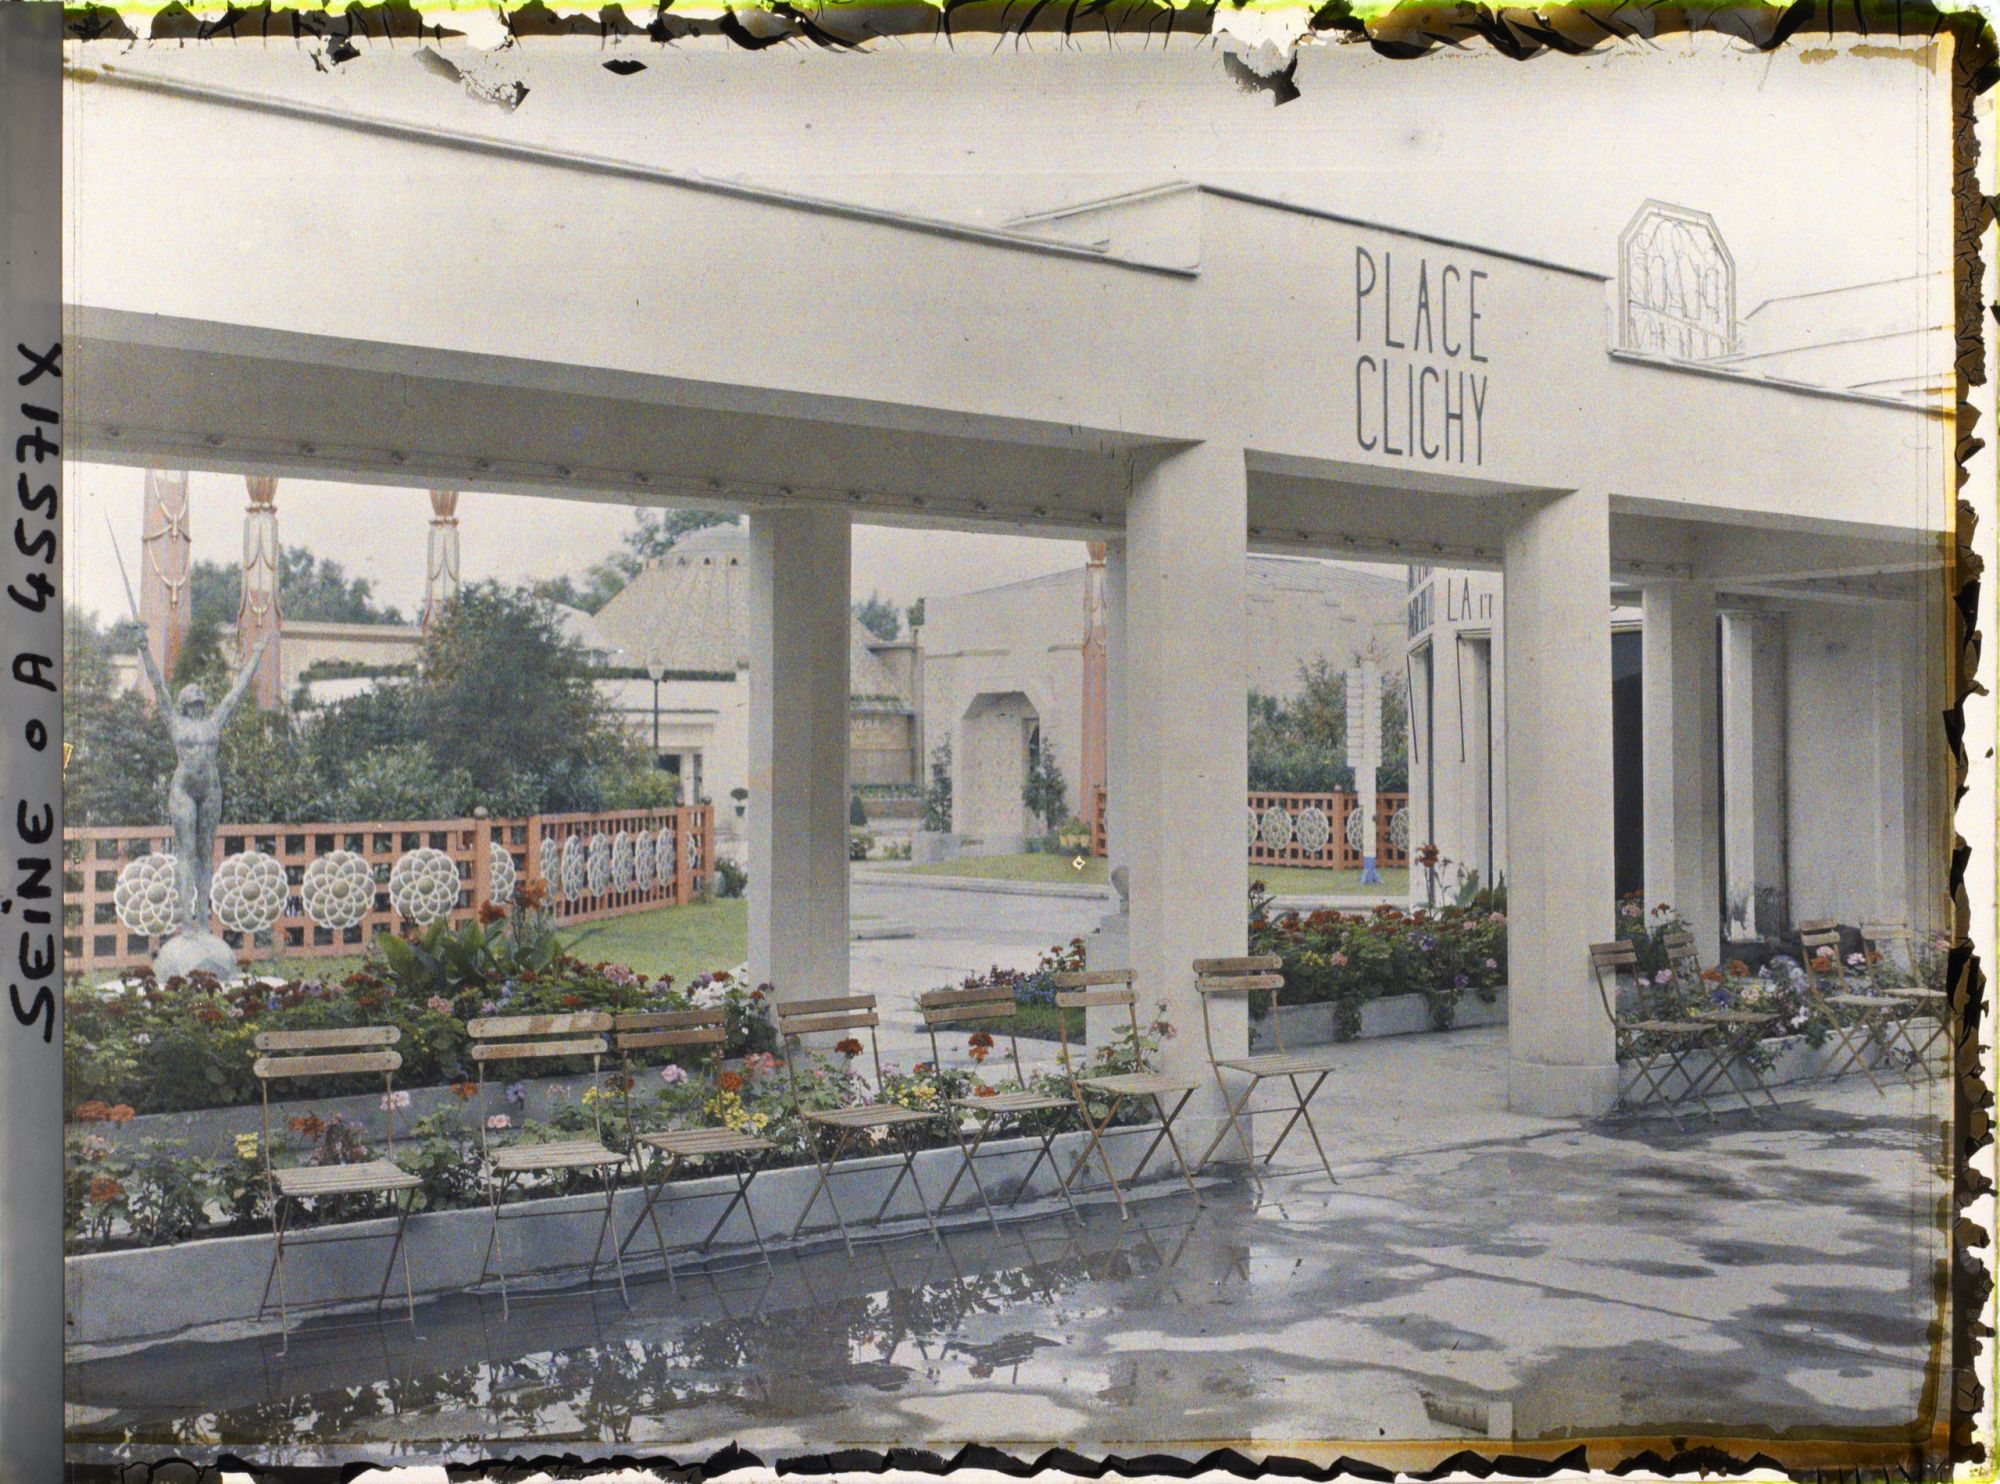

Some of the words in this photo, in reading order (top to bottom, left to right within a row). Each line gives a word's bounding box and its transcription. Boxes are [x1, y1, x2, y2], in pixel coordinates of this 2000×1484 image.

[1356, 246, 1489, 363] PLACE
[1355, 355, 1488, 466] CLICHY
[13, 653, 57, 692] A
